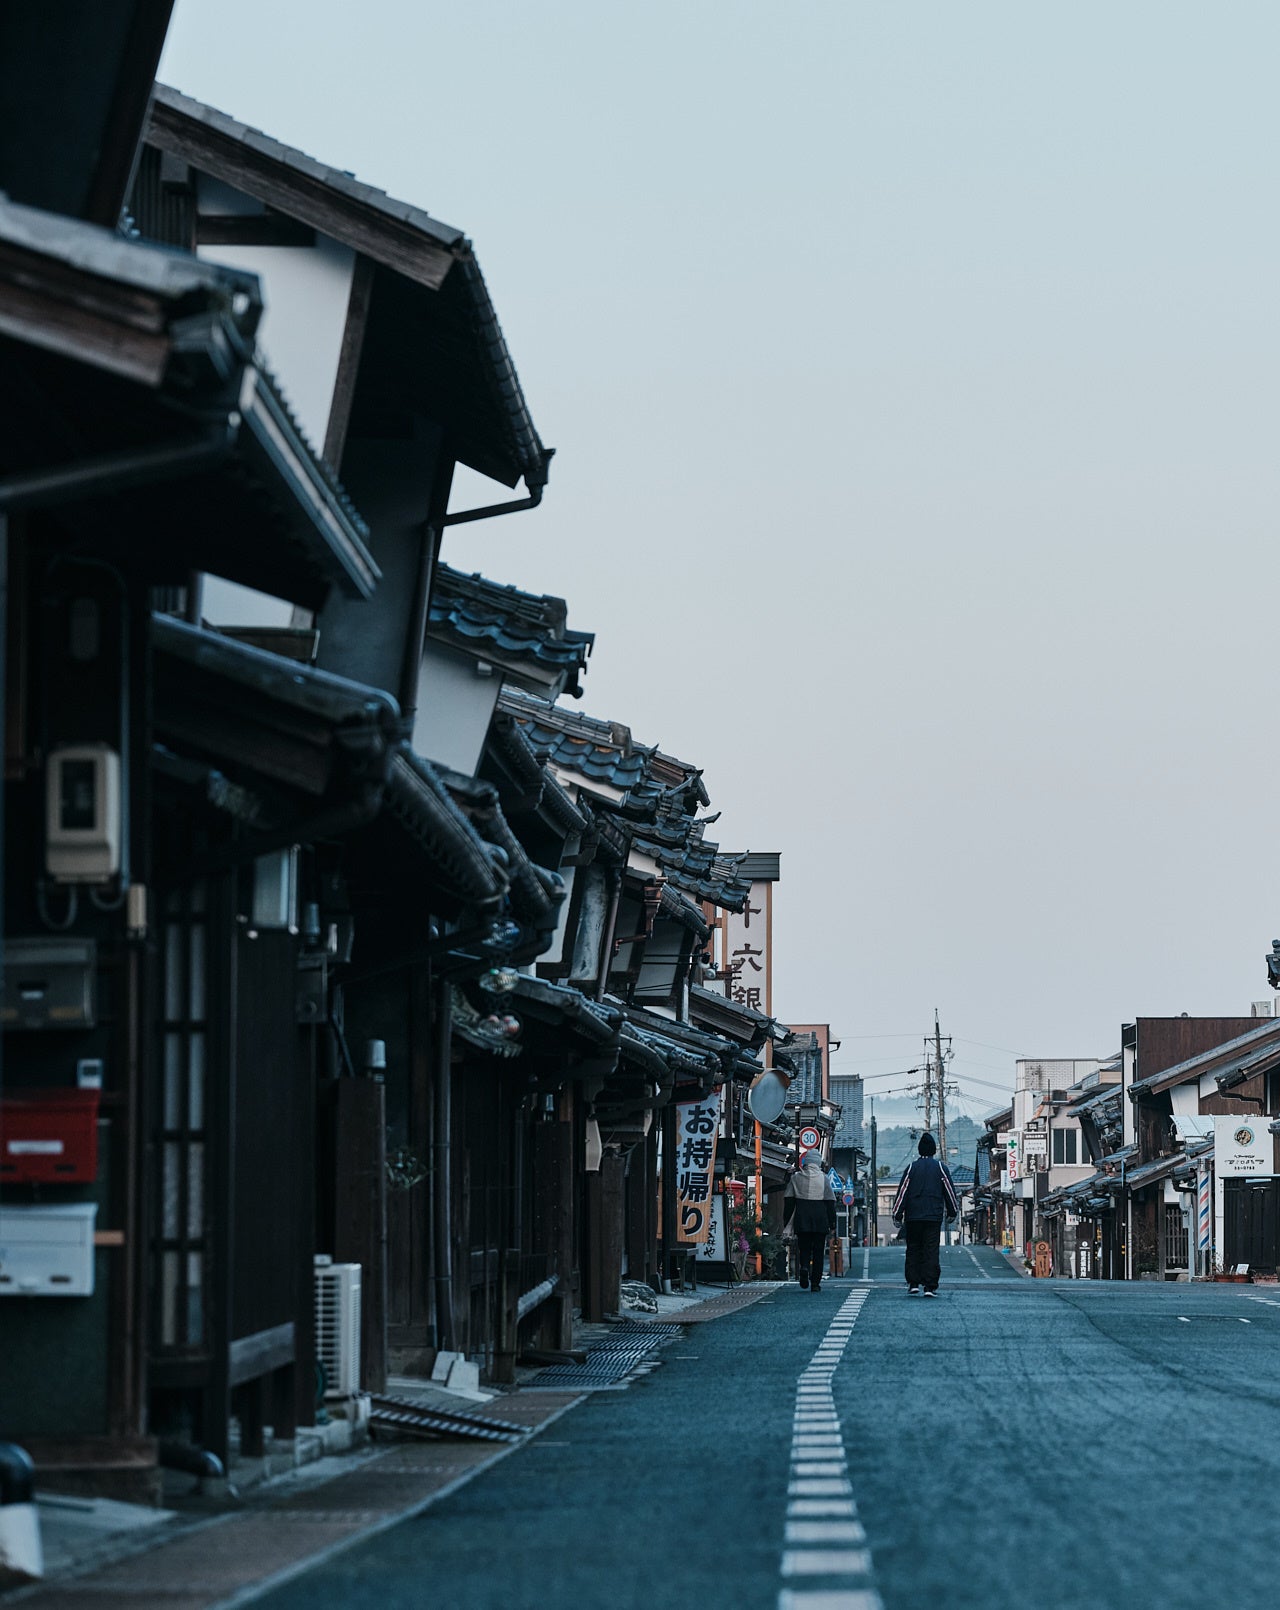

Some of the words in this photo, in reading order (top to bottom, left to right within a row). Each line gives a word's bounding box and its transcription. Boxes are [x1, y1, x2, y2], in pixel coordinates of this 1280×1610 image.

[803, 1133, 816, 1144] 30
[680, 1104, 717, 1236] お持帰り
[1009, 1150, 1017, 1179] くすり
